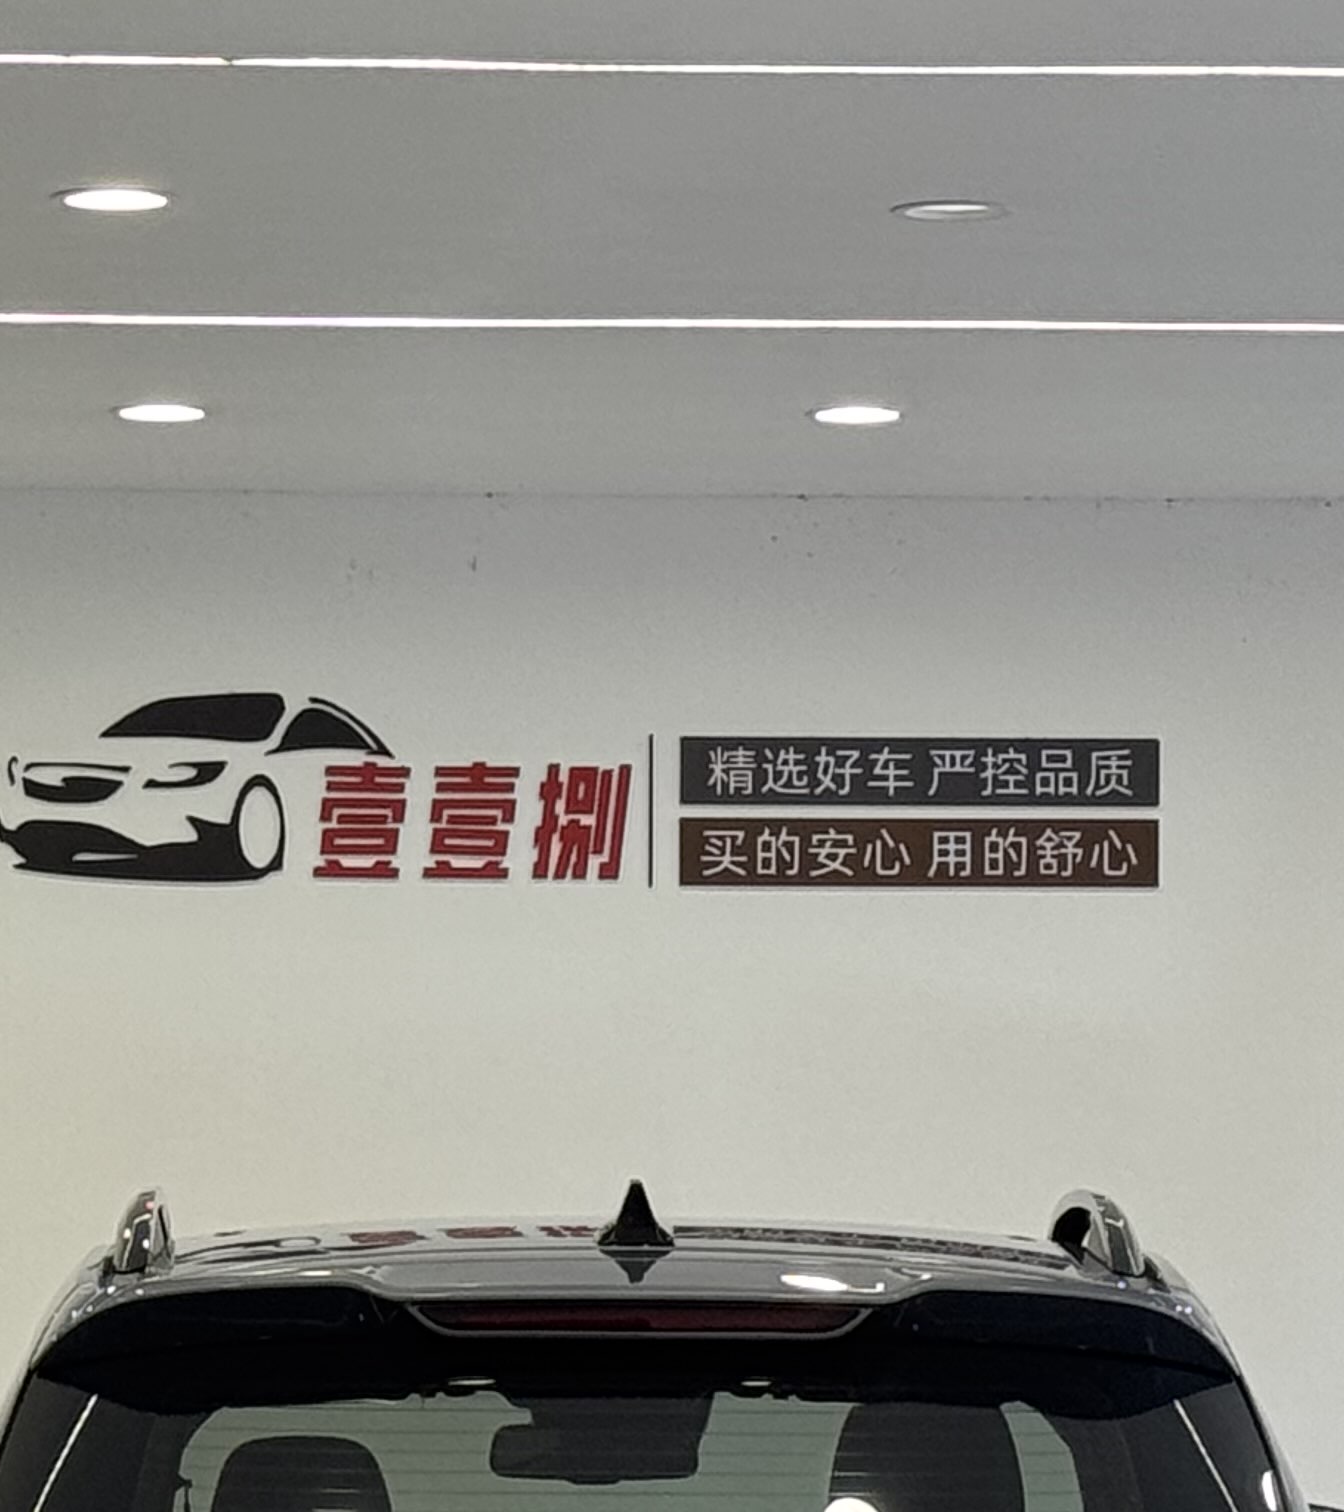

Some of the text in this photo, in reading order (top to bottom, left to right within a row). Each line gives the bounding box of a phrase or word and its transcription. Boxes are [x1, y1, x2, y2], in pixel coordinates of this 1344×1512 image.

[707, 745, 1134, 797] 精选好车 严控品质
[312, 761, 632, 880] 壹壹捌
[700, 826, 1139, 878] 买的安心 用的舒心
